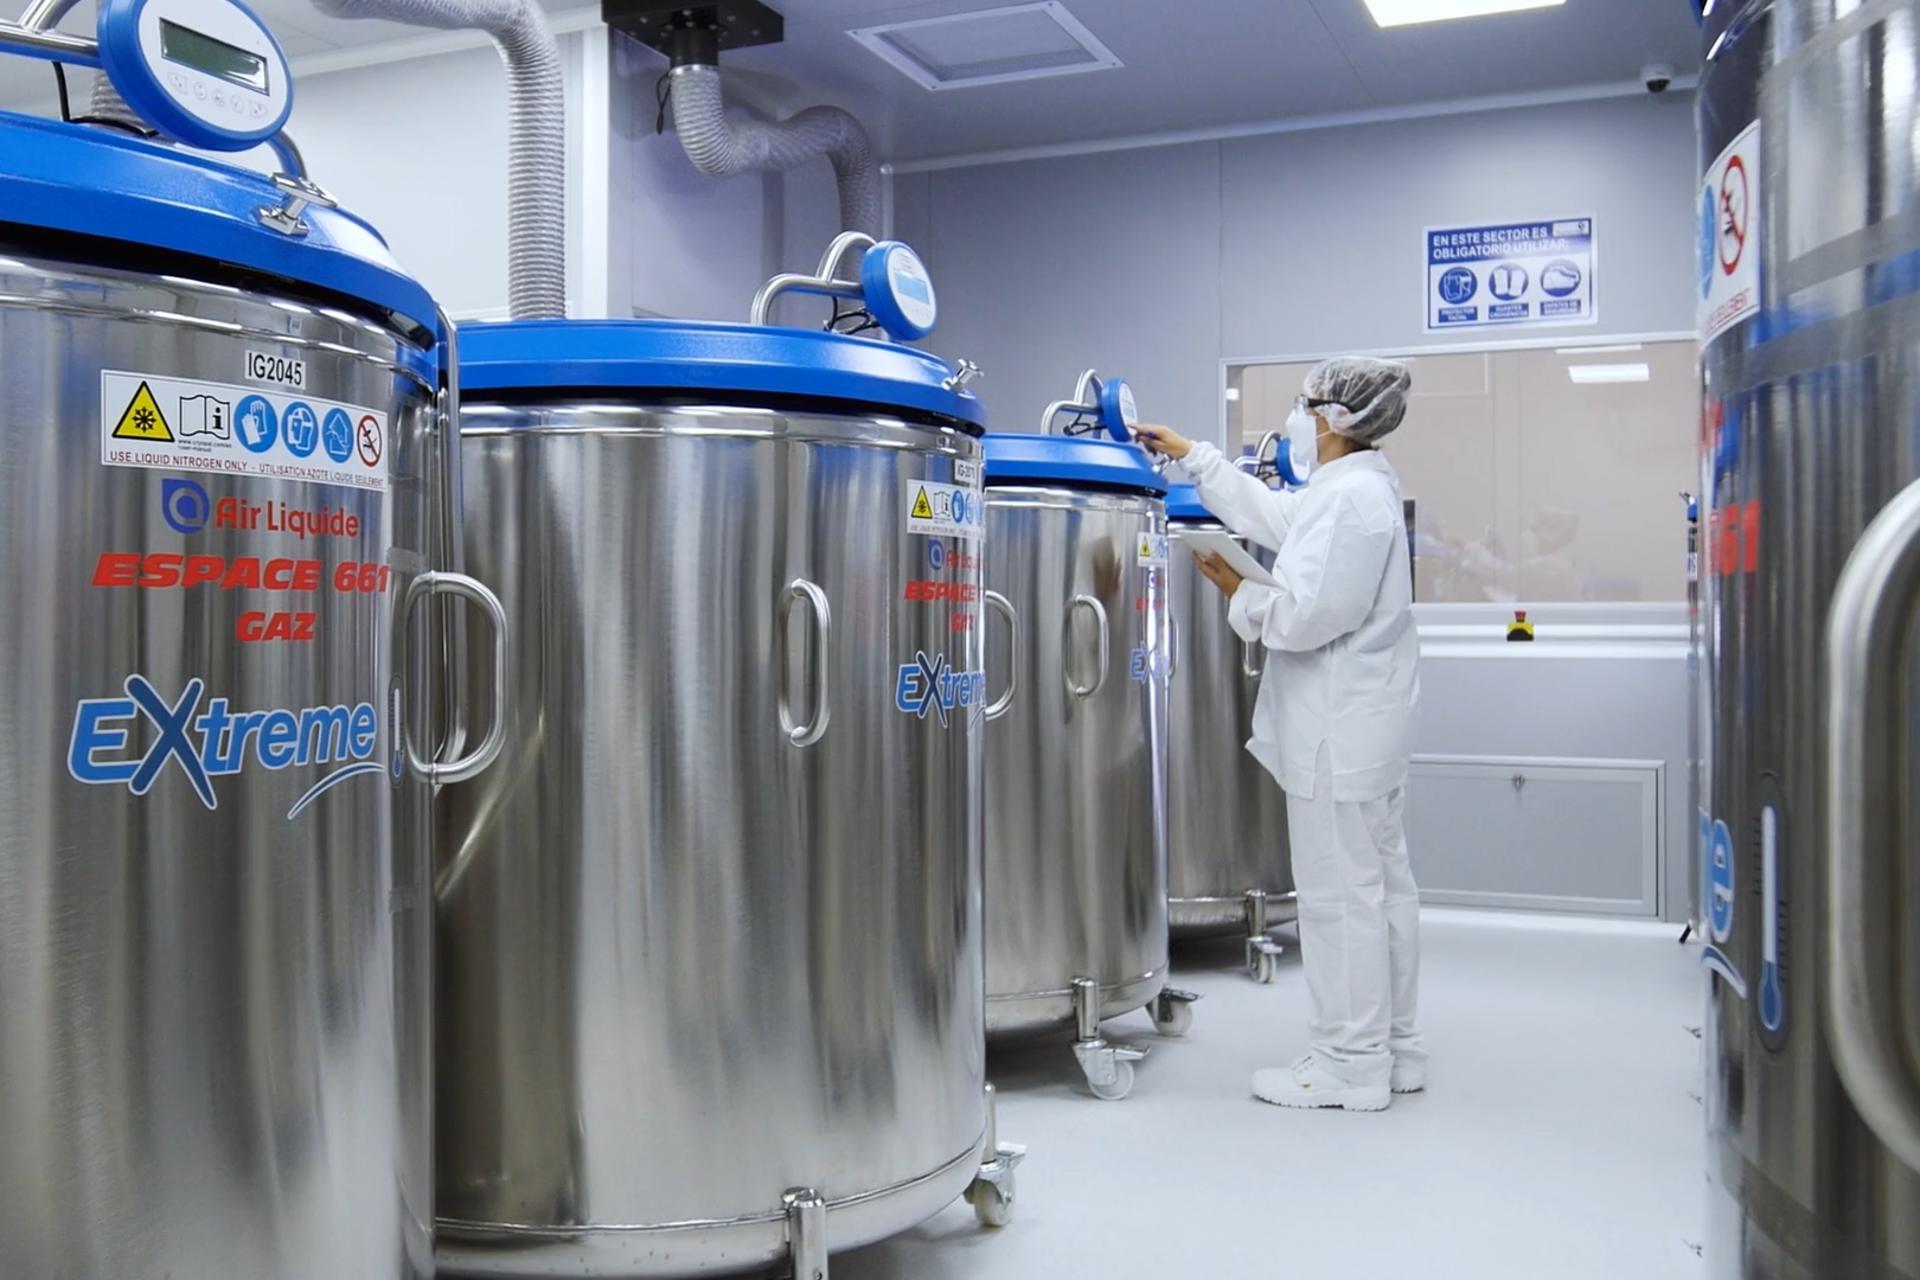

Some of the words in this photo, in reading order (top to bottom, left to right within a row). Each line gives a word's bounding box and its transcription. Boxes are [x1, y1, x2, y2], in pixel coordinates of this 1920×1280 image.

[1433, 234, 1449, 247] EN
[1451, 232, 1480, 245] ESTE
[1483, 229, 1530, 242] SECTOR
[1532, 226, 1548, 239] ES
[1433, 242, 1512, 260] OBLIGATORIO
[248, 352, 302, 385] IG2045
[110, 451, 132, 461] USE
[135, 453, 170, 465] LIQUID
[172, 456, 221, 469] NITROGEN
[224, 460, 247, 471] ONLY
[259, 463, 306, 476] UTILISATION
[307, 468, 329, 481] AZOTE
[216, 496, 261, 530] Air
[267, 500, 359, 539] Liquide
[91, 552, 323, 591] ESPACE
[334, 561, 391, 593] 661
[904, 580, 977, 602] ESPACE
[235, 611, 318, 642] GAZ
[67, 673, 378, 810] EXtreme
